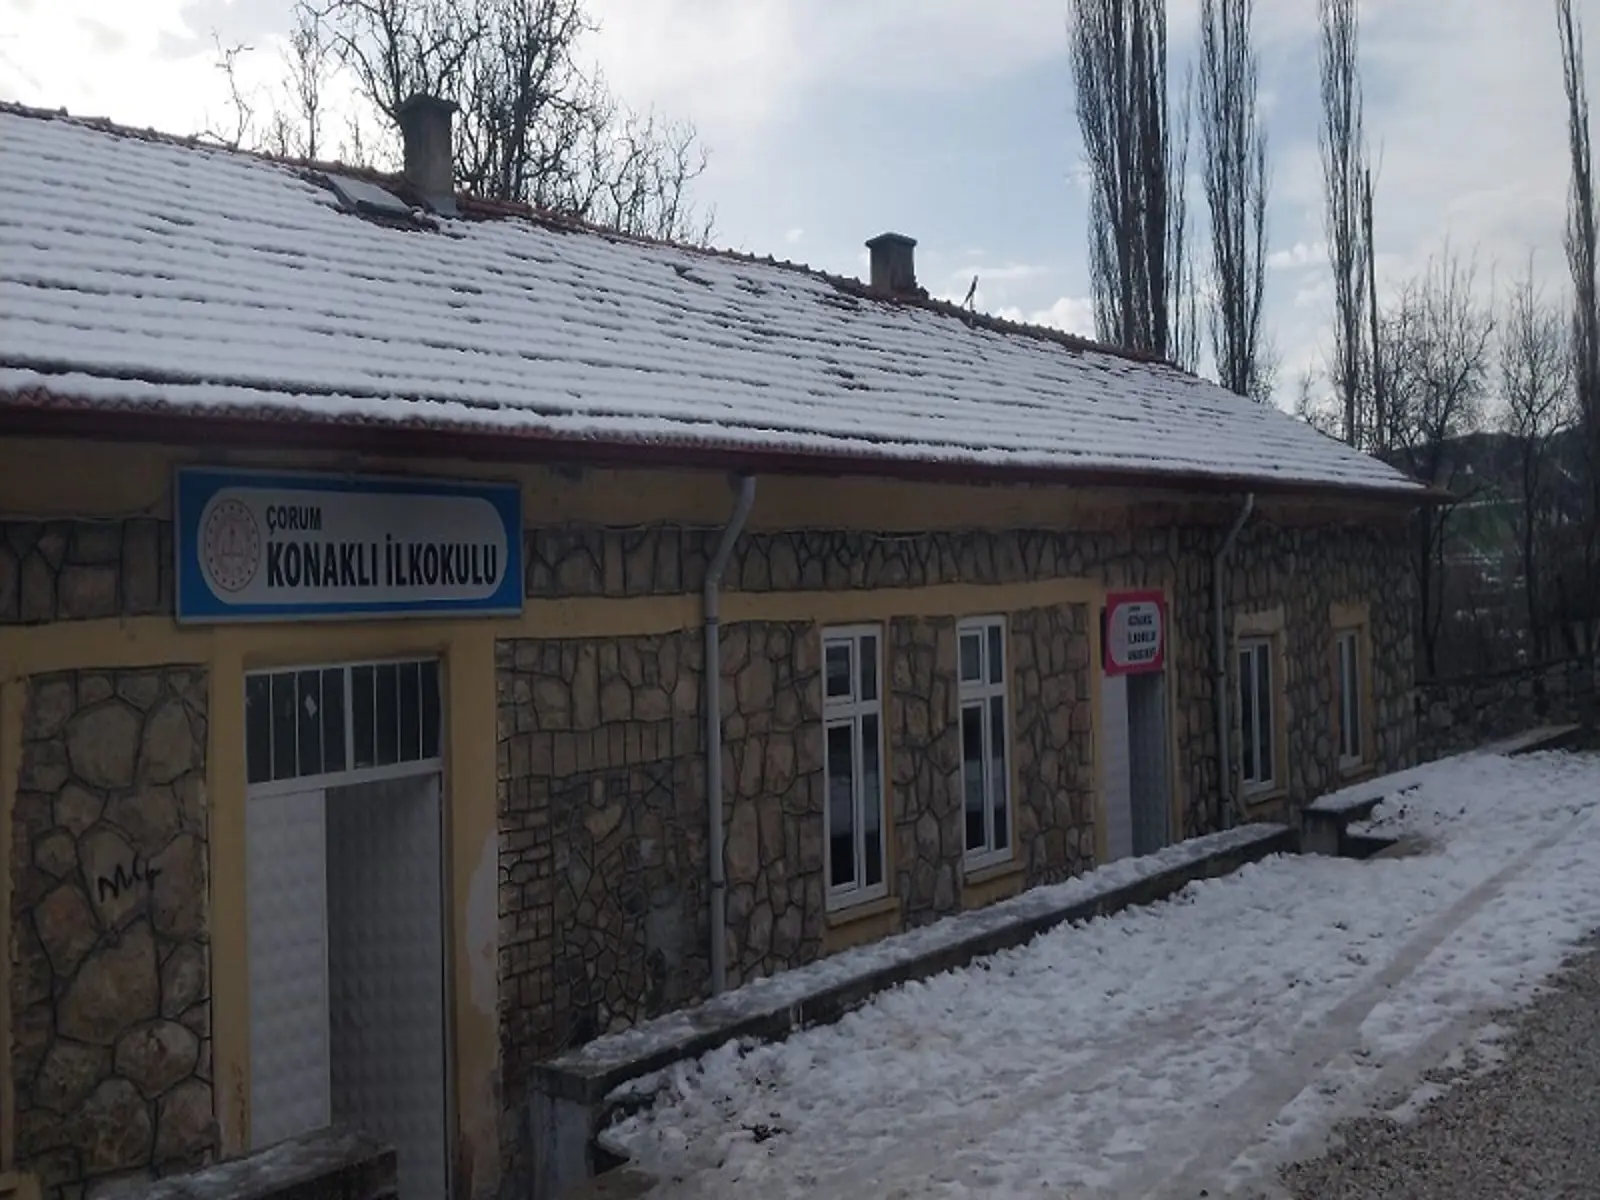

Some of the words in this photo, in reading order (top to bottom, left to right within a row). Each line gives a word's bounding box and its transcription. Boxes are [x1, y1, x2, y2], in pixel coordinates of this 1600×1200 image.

[266, 505, 322, 533] ÇORUM
[267, 541, 378, 588] KONAKLI
[386, 533, 498, 587] İLKOKULU
